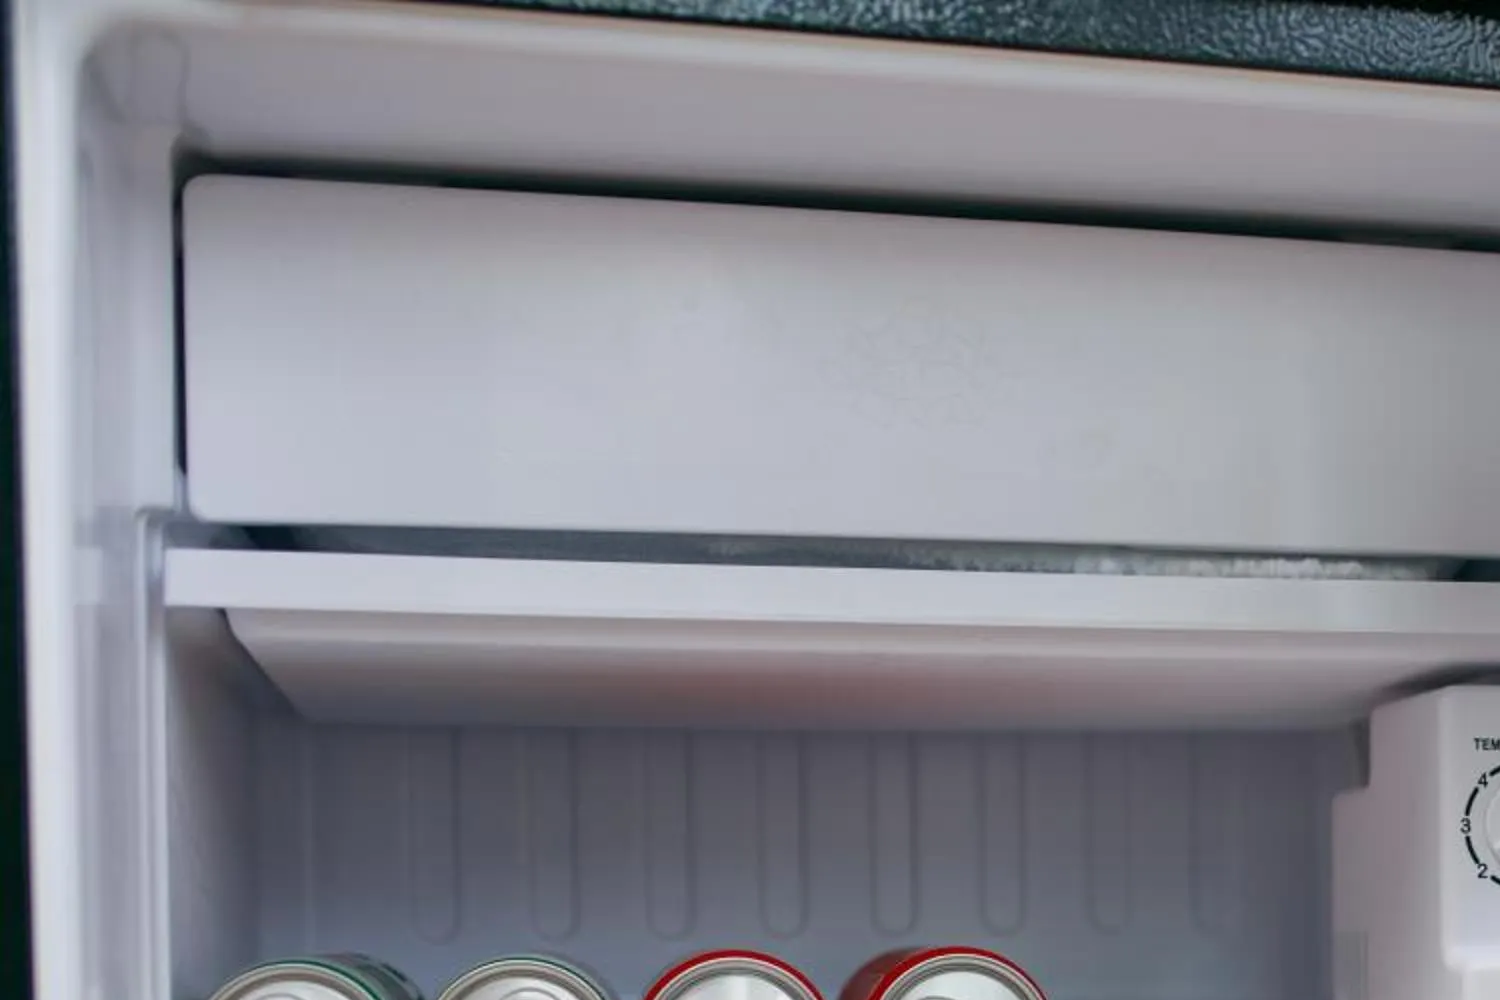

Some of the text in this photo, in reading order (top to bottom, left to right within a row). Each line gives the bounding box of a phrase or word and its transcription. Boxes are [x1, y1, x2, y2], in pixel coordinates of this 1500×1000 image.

[1478, 773, 1488, 788] 4
[1460, 818, 1471, 834] 3
[1477, 863, 1488, 879] 2
